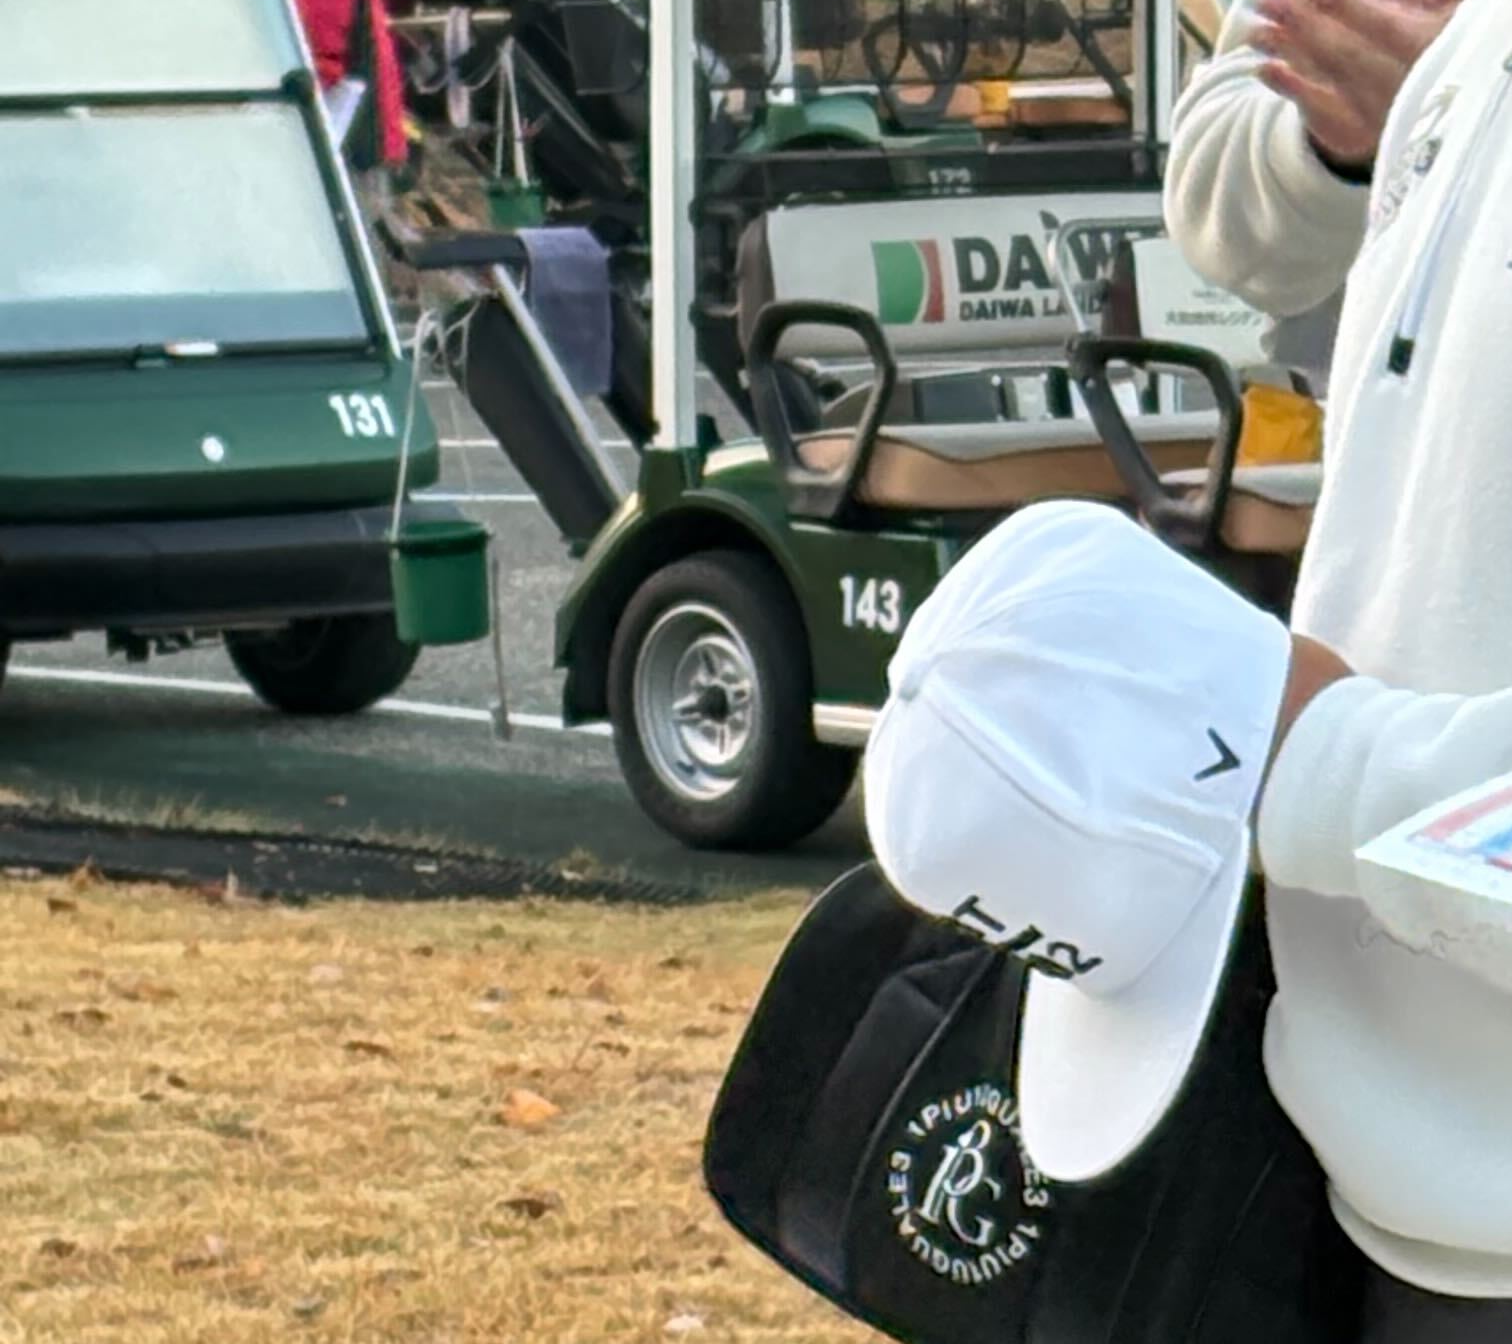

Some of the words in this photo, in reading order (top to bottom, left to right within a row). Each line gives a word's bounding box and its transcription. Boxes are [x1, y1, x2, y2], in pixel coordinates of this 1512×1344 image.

[959, 297, 1035, 321] DAIWA
[328, 393, 395, 438] 131
[839, 575, 900, 634] 143
